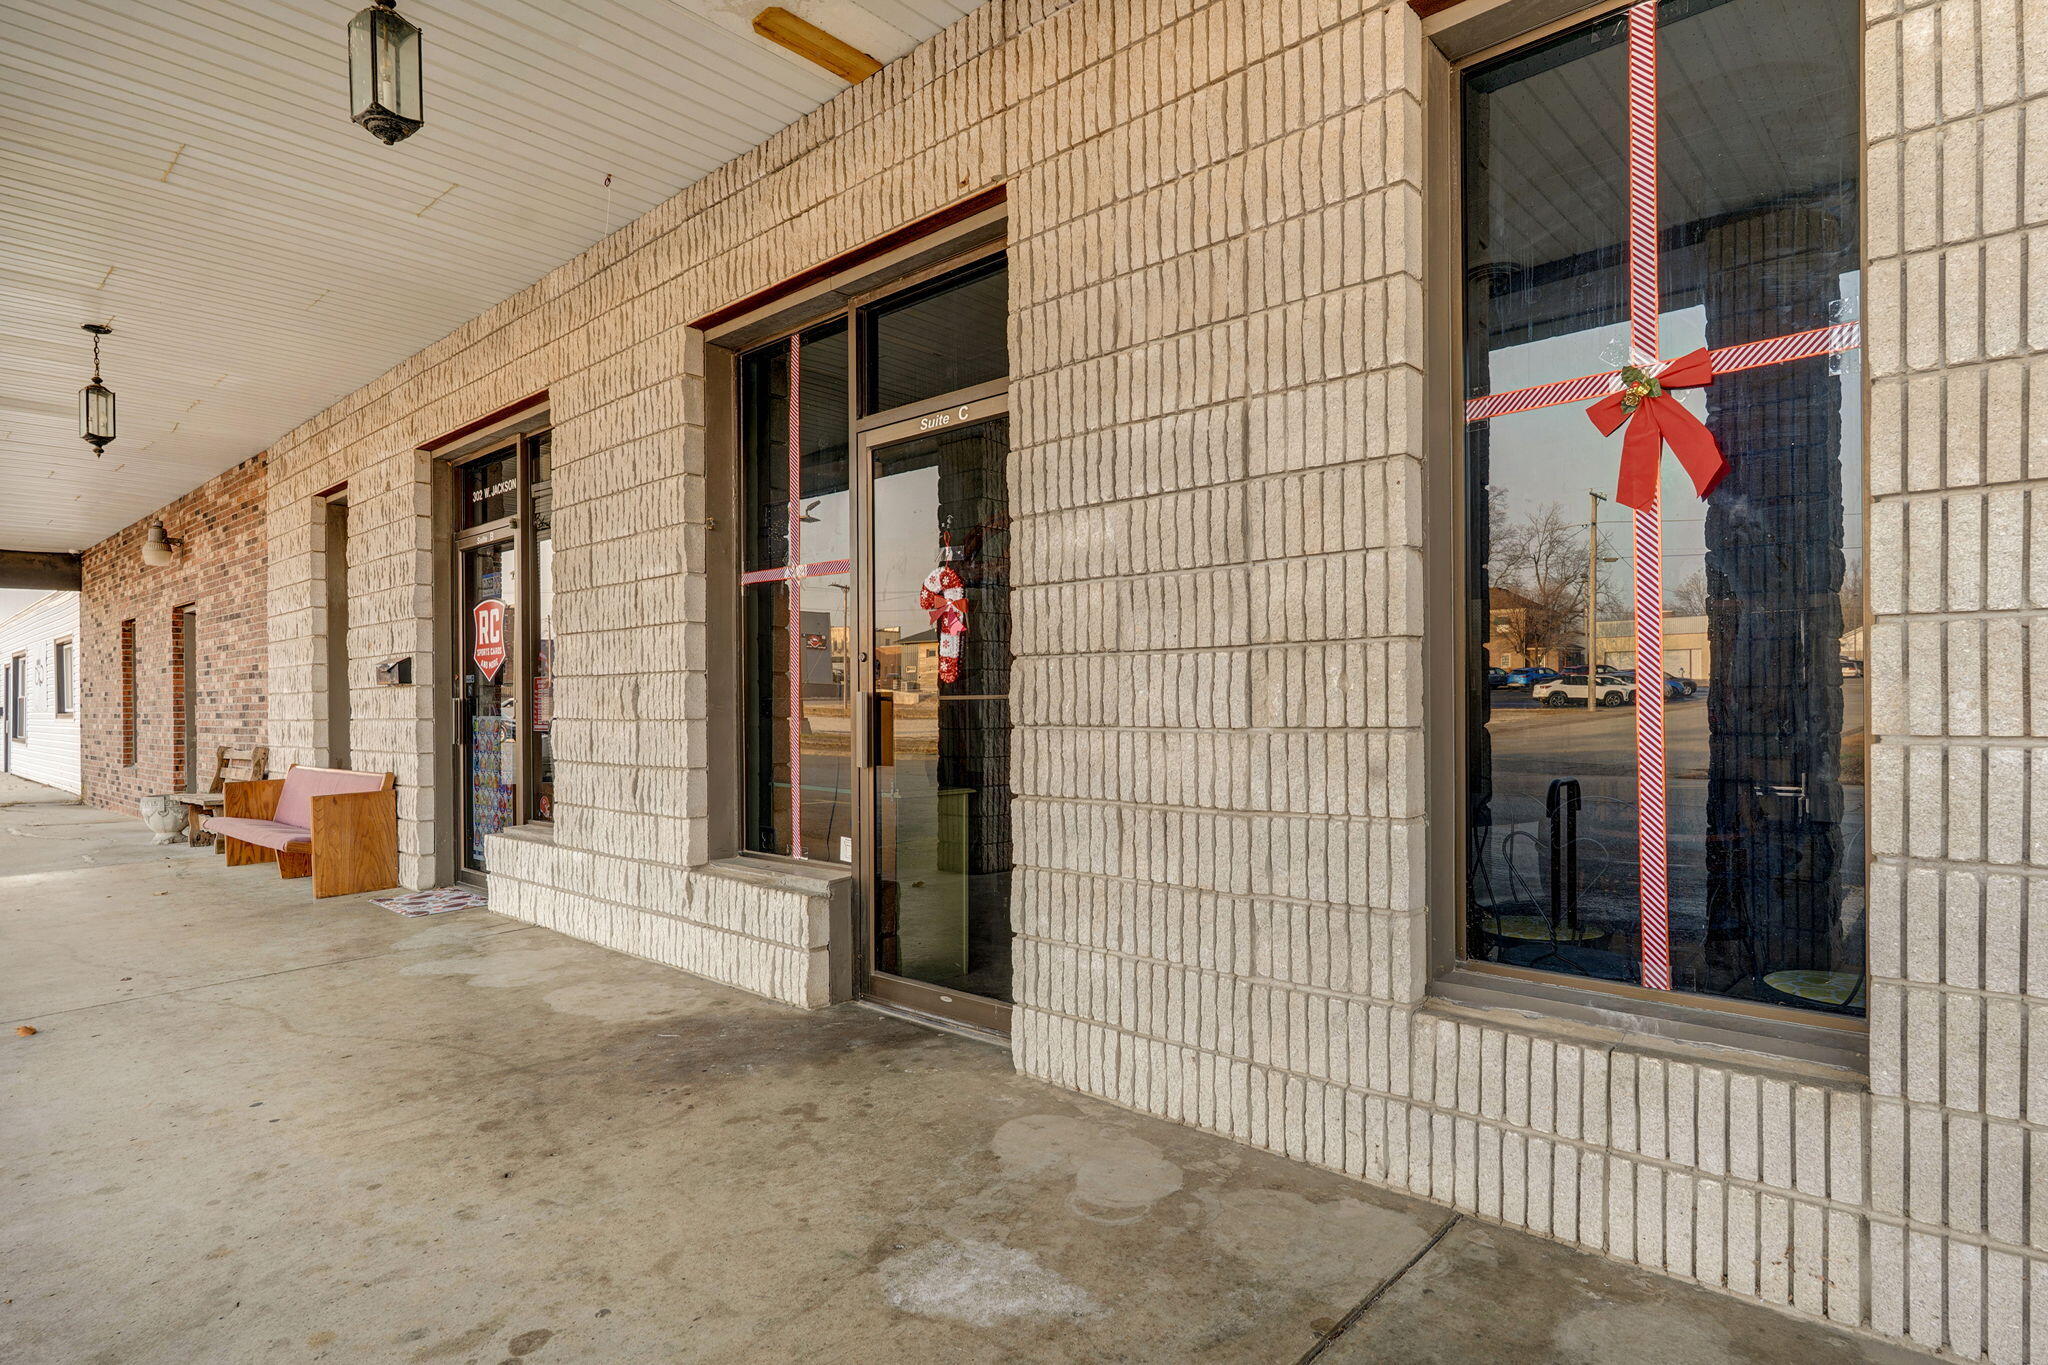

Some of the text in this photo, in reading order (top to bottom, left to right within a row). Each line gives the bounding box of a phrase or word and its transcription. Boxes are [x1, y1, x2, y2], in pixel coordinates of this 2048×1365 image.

[920, 405, 969, 431] Suite C
[472, 490, 483, 502] 302
[491, 478, 517, 496] JACKSON
[479, 608, 500, 645] RC
